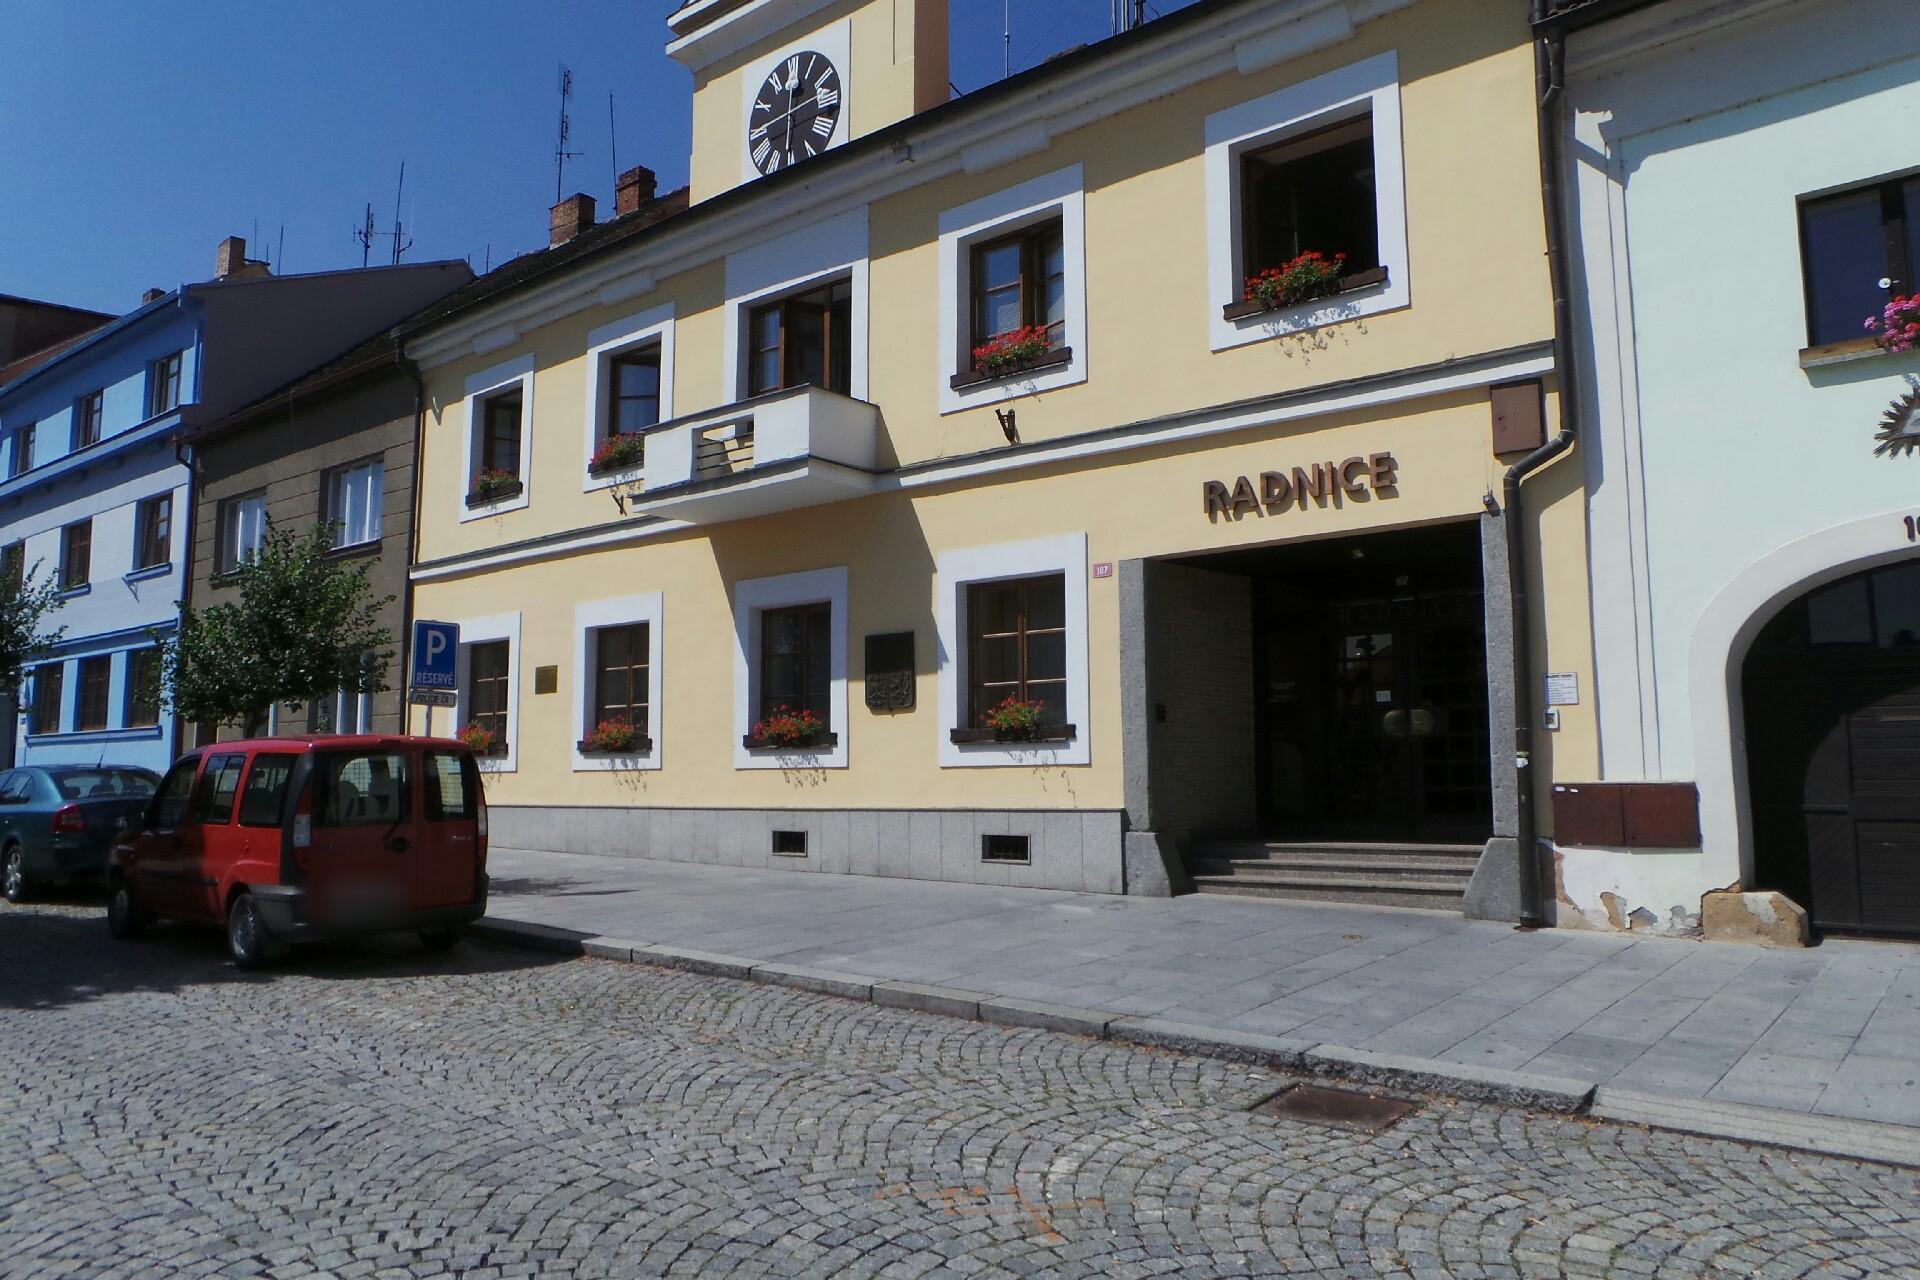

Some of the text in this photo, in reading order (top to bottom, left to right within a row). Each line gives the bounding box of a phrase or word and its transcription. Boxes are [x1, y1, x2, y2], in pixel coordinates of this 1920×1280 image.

[768, 72, 783, 95] XI
[755, 99, 771, 112] X
[1203, 450, 1394, 516] RADNICE
[1903, 515, 1920, 542] 1
[1096, 565, 1109, 576] 107
[425, 629, 446, 666] P
